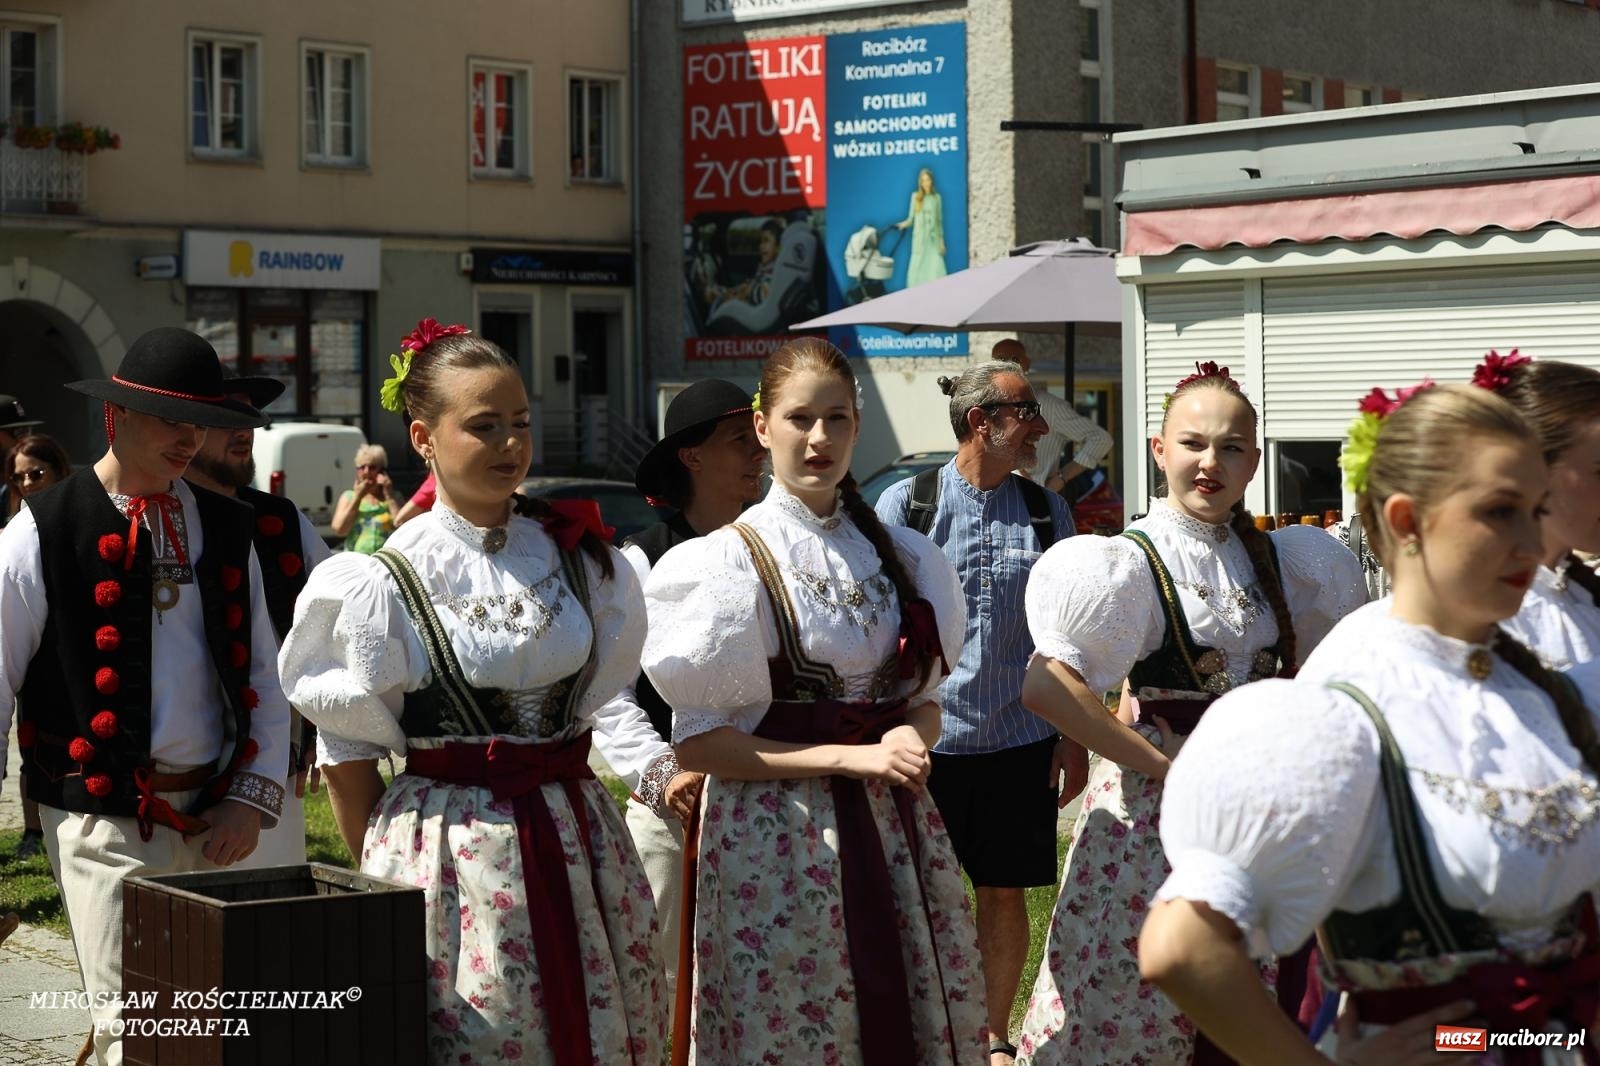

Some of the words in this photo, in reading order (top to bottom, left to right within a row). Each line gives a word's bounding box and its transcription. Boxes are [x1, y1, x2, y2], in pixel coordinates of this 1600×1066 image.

[862, 36, 927, 57] Racibórz
[687, 44, 822, 85] FOTELIKI
[845, 60, 932, 81] Komunalna
[935, 57, 945, 74] 7
[863, 91, 927, 111] FOTELIKI
[691, 97, 822, 142] RATUJĄ
[834, 113, 957, 136] SAMOCHODOWE
[833, 140, 882, 158] WÓZKI
[884, 136, 959, 156] DZIECIĘCE
[694, 153, 813, 199] ŻYCIE!
[259, 250, 344, 271] RAINBOW
[695, 338, 788, 358] FOTELIKOW
